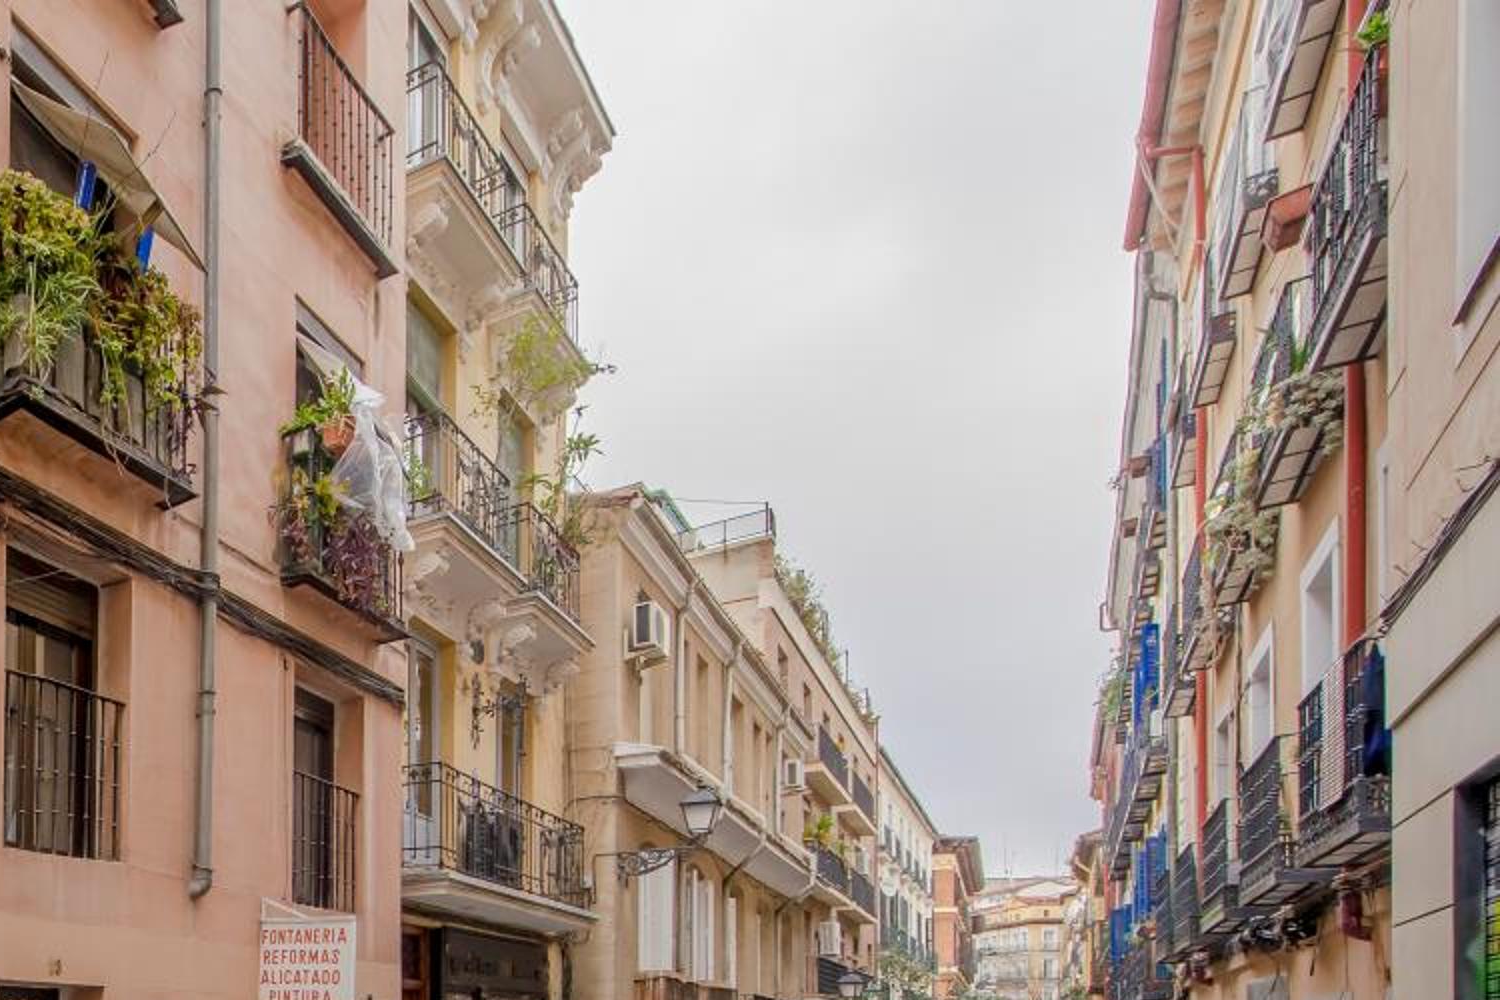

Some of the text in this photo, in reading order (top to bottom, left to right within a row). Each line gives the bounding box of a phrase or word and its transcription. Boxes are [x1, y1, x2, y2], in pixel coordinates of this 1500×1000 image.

[261, 927, 347, 944] FONTANERIA
[263, 949, 340, 965] REFORMAS
[260, 969, 341, 985] ALICATADO
